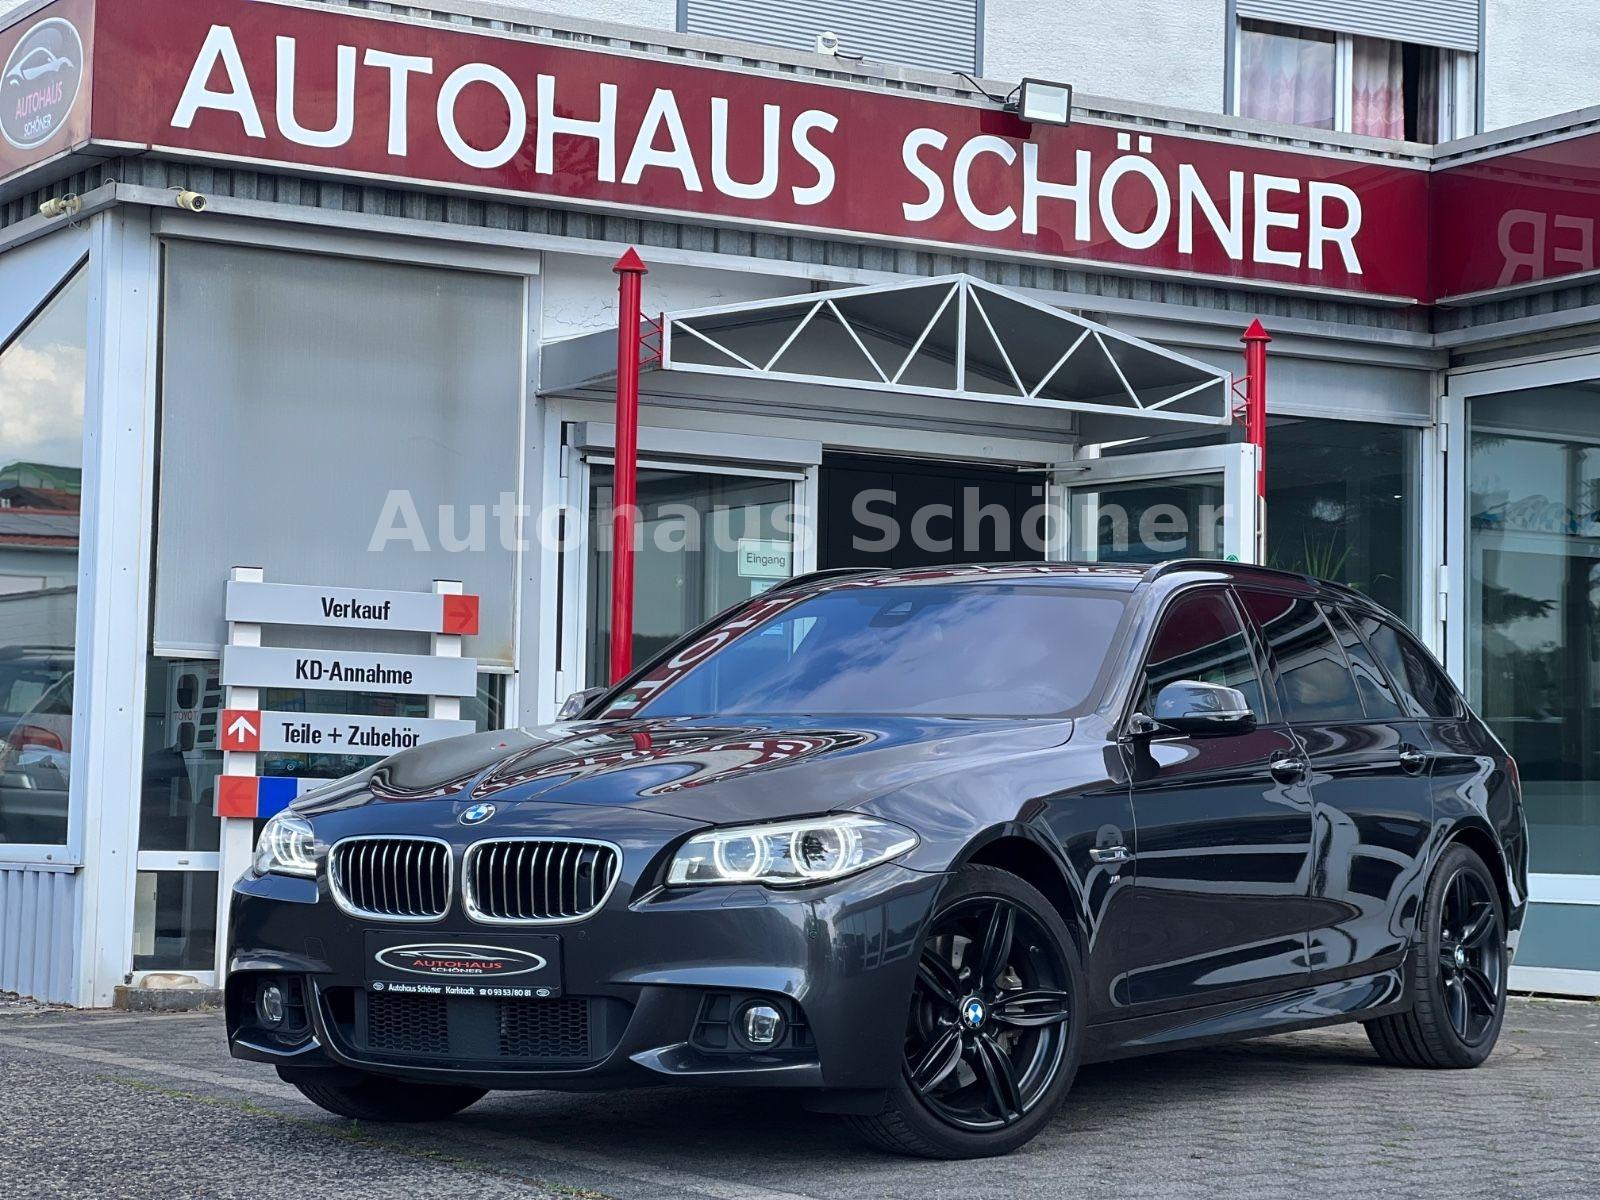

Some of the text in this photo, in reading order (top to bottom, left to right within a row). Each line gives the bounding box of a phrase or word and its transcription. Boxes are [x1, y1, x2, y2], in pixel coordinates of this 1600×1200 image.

[15, 81, 63, 120] AUTOHAUS
[24, 114, 52, 137] SCHÖNER
[170, 25, 1363, 275] AUTOHAUS SCHÖNER
[747, 552, 786, 567] Eingang
[321, 597, 391, 621] Verkauf
[296, 659, 413, 685] KD-Annahme
[282, 723, 322, 744] Teile
[347, 724, 421, 748] Zubehör
[413, 959, 502, 969] AUTOHAUS
[430, 966, 483, 974] SCHÖNER
[388, 983, 417, 993] Autohaus
[417, 984, 442, 994] Schöner
[445, 986, 475, 996] Karlstadt
